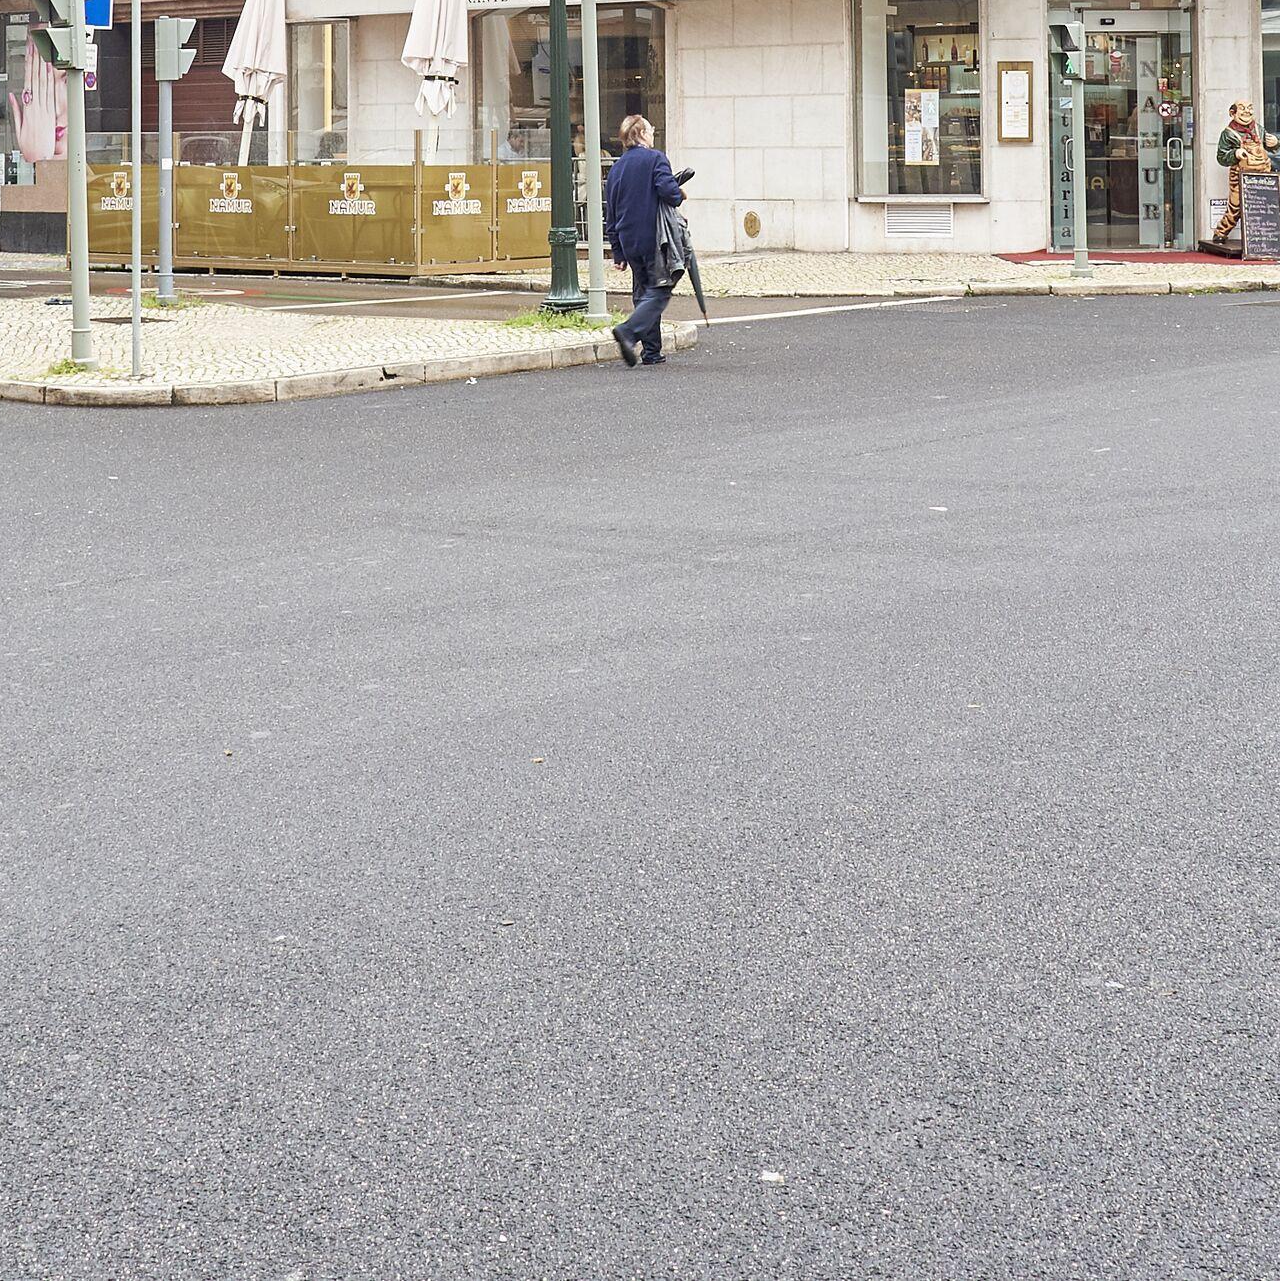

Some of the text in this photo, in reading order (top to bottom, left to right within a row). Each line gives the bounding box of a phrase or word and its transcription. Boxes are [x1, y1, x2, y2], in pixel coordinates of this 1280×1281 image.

[101, 196, 132, 211] NAMU
[209, 198, 252, 213] NAMUR
[329, 199, 376, 216] NAMUR
[433, 199, 482, 216] NAMUR
[506, 197, 552, 213] NAMUR
